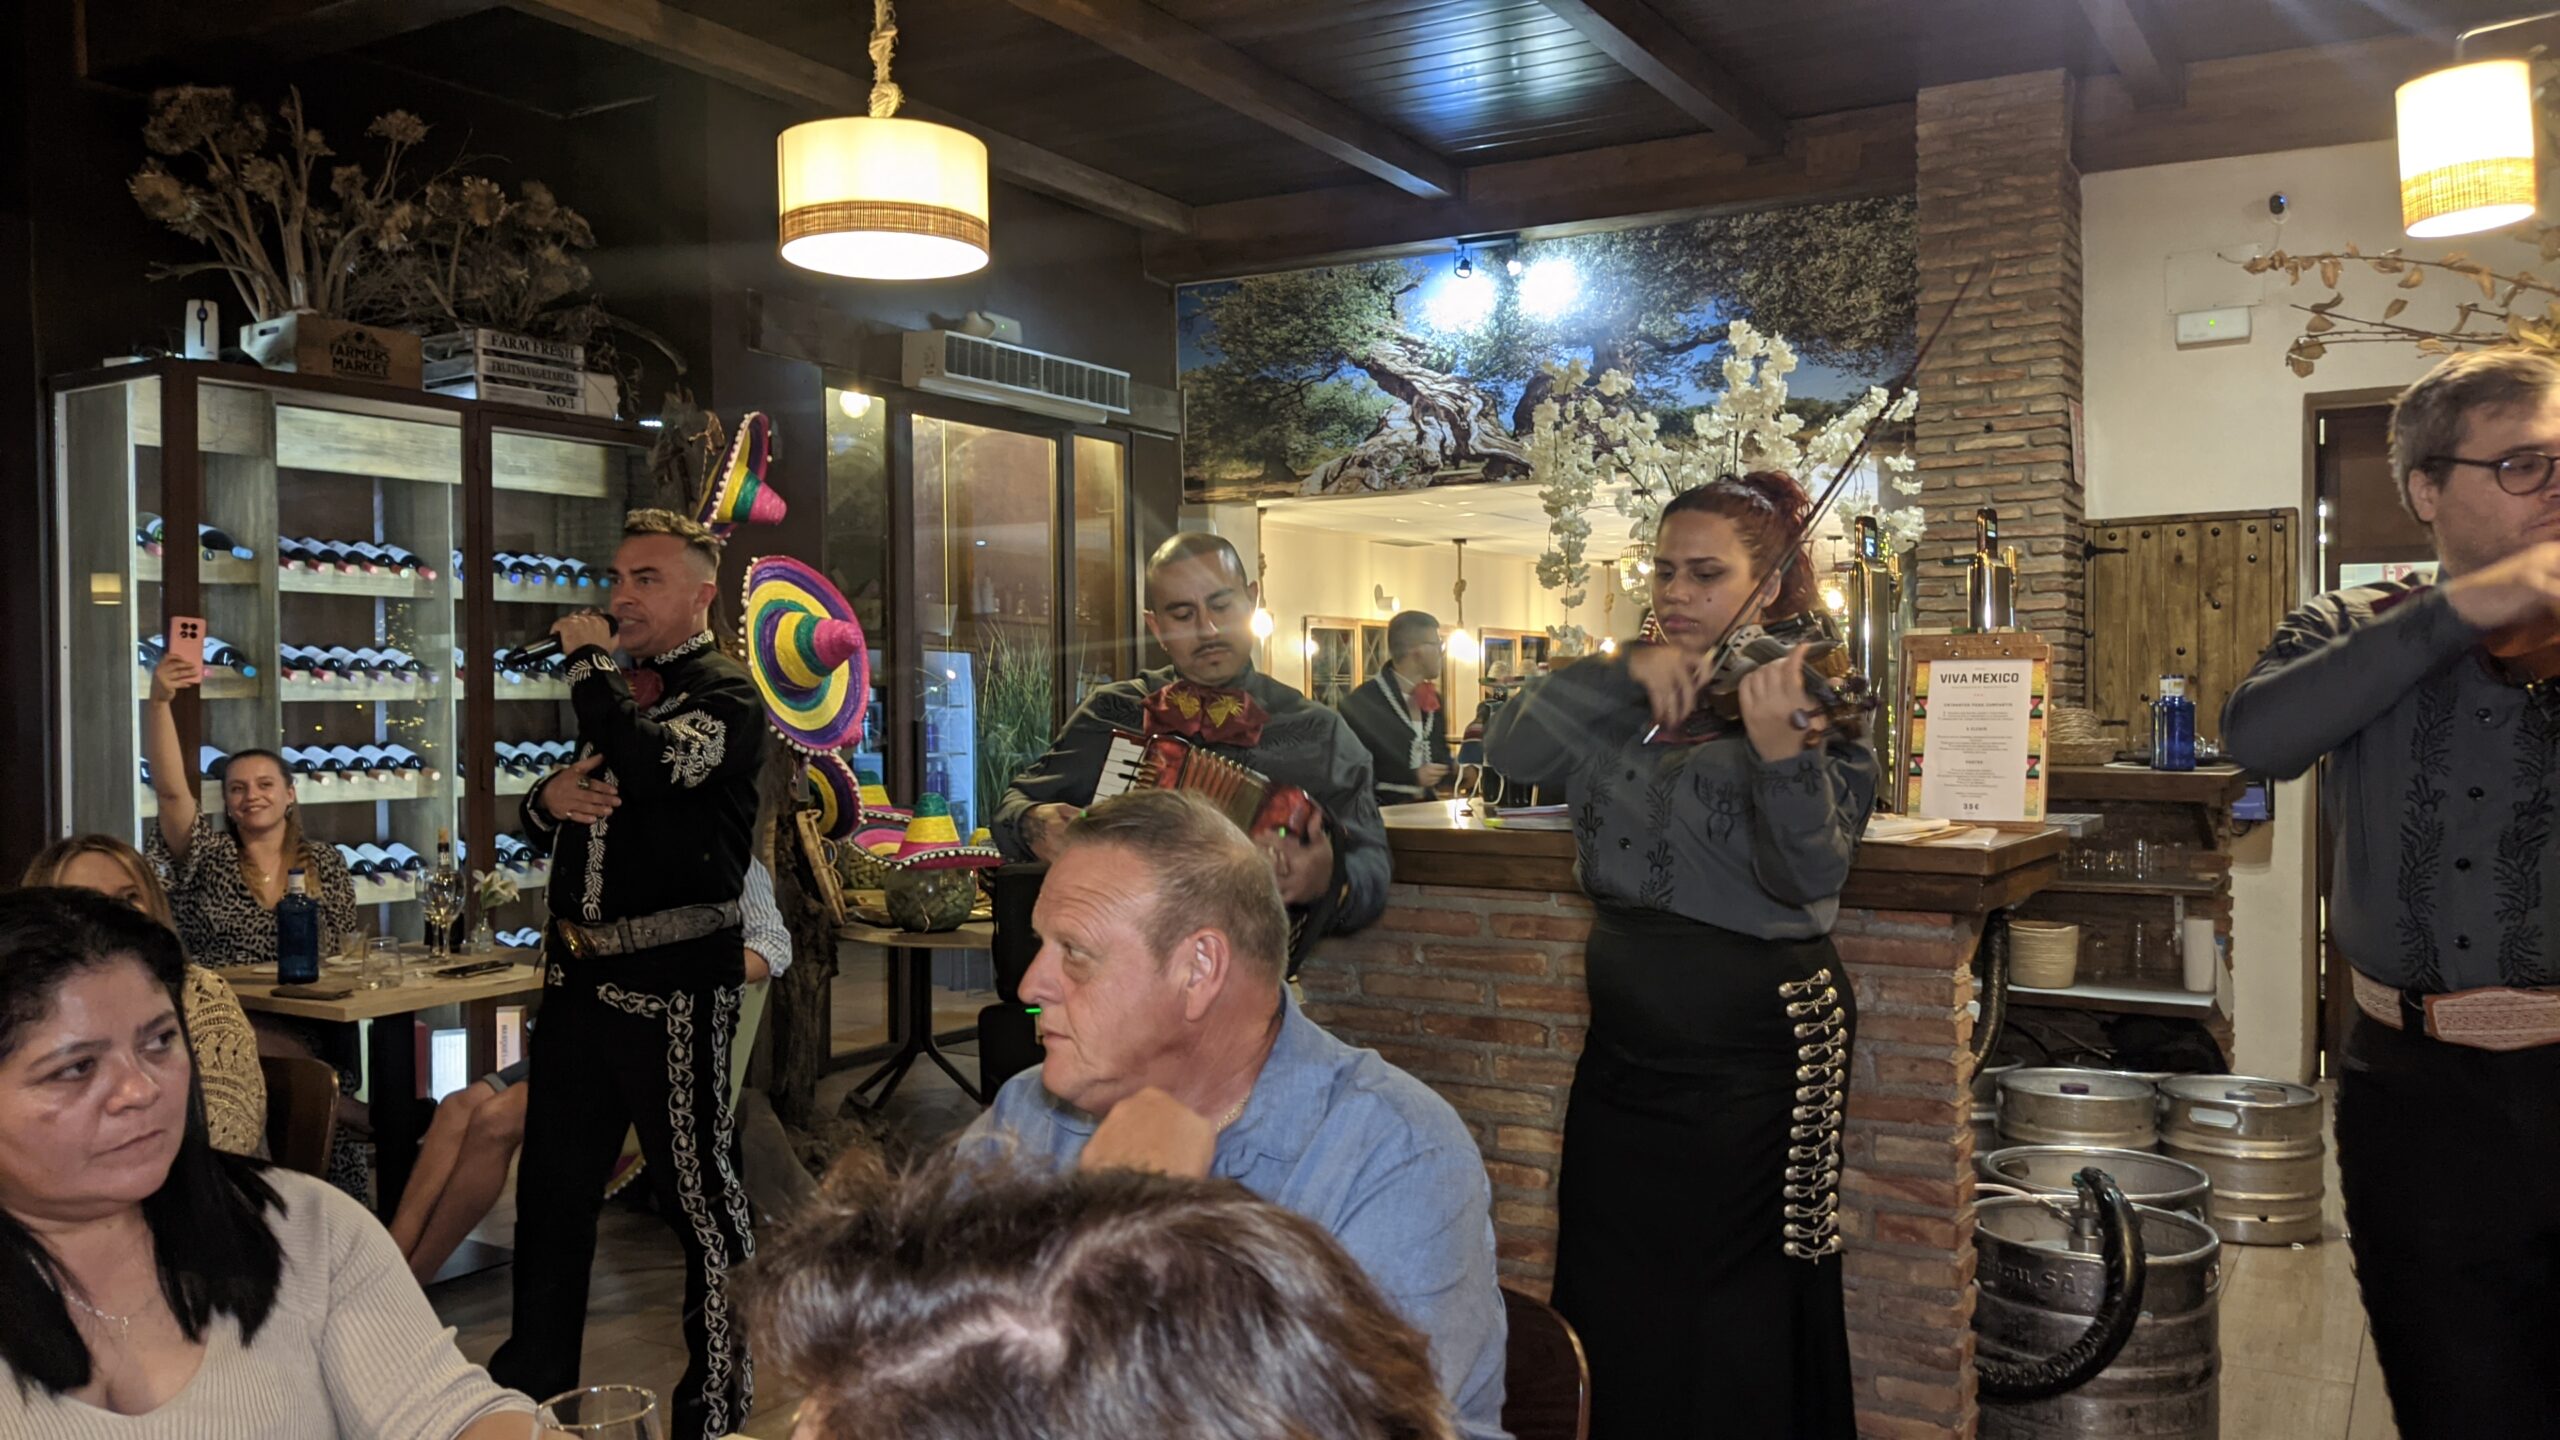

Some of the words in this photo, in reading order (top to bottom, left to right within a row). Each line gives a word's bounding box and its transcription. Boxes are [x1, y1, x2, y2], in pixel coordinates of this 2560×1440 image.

[330, 344, 390, 361] FARMERS
[491, 335, 529, 352] FARM
[534, 341, 575, 359] FRESH
[333, 357, 387, 375] MARKET
[1940, 673, 1968, 683] VIVA
[1972, 673, 2019, 683] MEXICO
